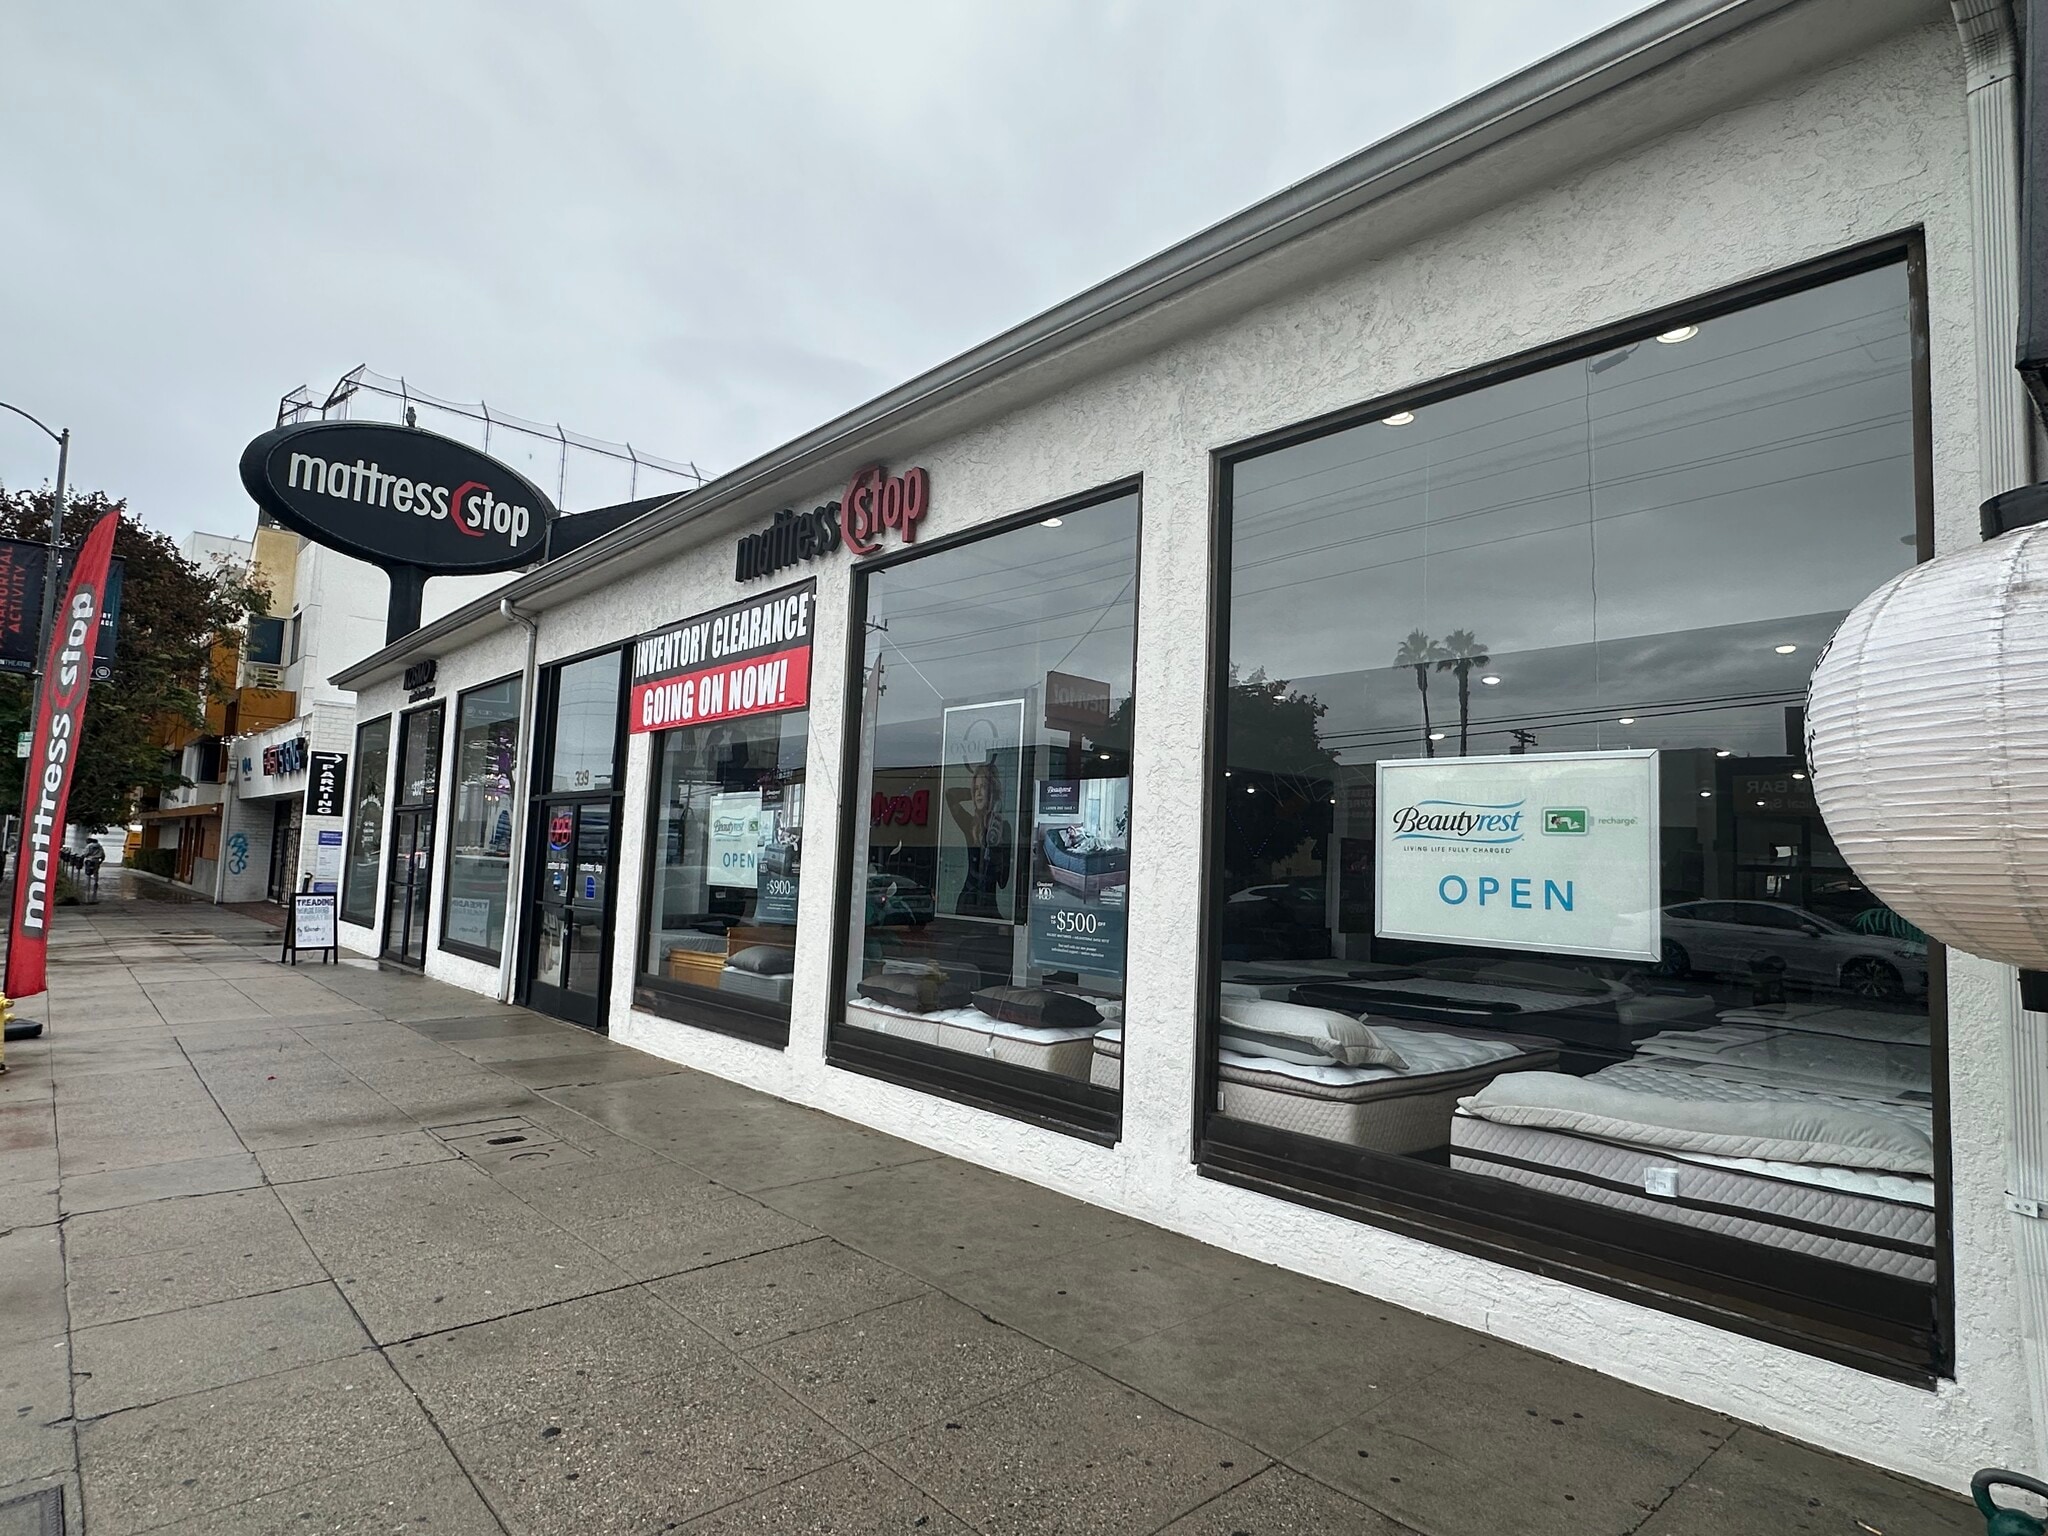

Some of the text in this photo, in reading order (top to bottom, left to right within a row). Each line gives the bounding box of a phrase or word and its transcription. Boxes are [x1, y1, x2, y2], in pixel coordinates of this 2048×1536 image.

[288, 452, 530, 547] mattress stop
[735, 465, 930, 582] mattress stop
[9, 565, 26, 633] ACTIVITY
[635, 592, 810, 679] INVENTORY CLEARANCE
[642, 658, 789, 727] GOING ON NOW!
[24, 592, 94, 930] mattress stop
[574, 770, 590, 787] 339
[317, 763, 335, 814] PARKING
[1393, 804, 1524, 837] Beautyrest
[723, 852, 755, 868] OPEN
[769, 879, 791, 895] $900
[1439, 875, 1574, 912] OPEN
[1056, 909, 1097, 934] $500
